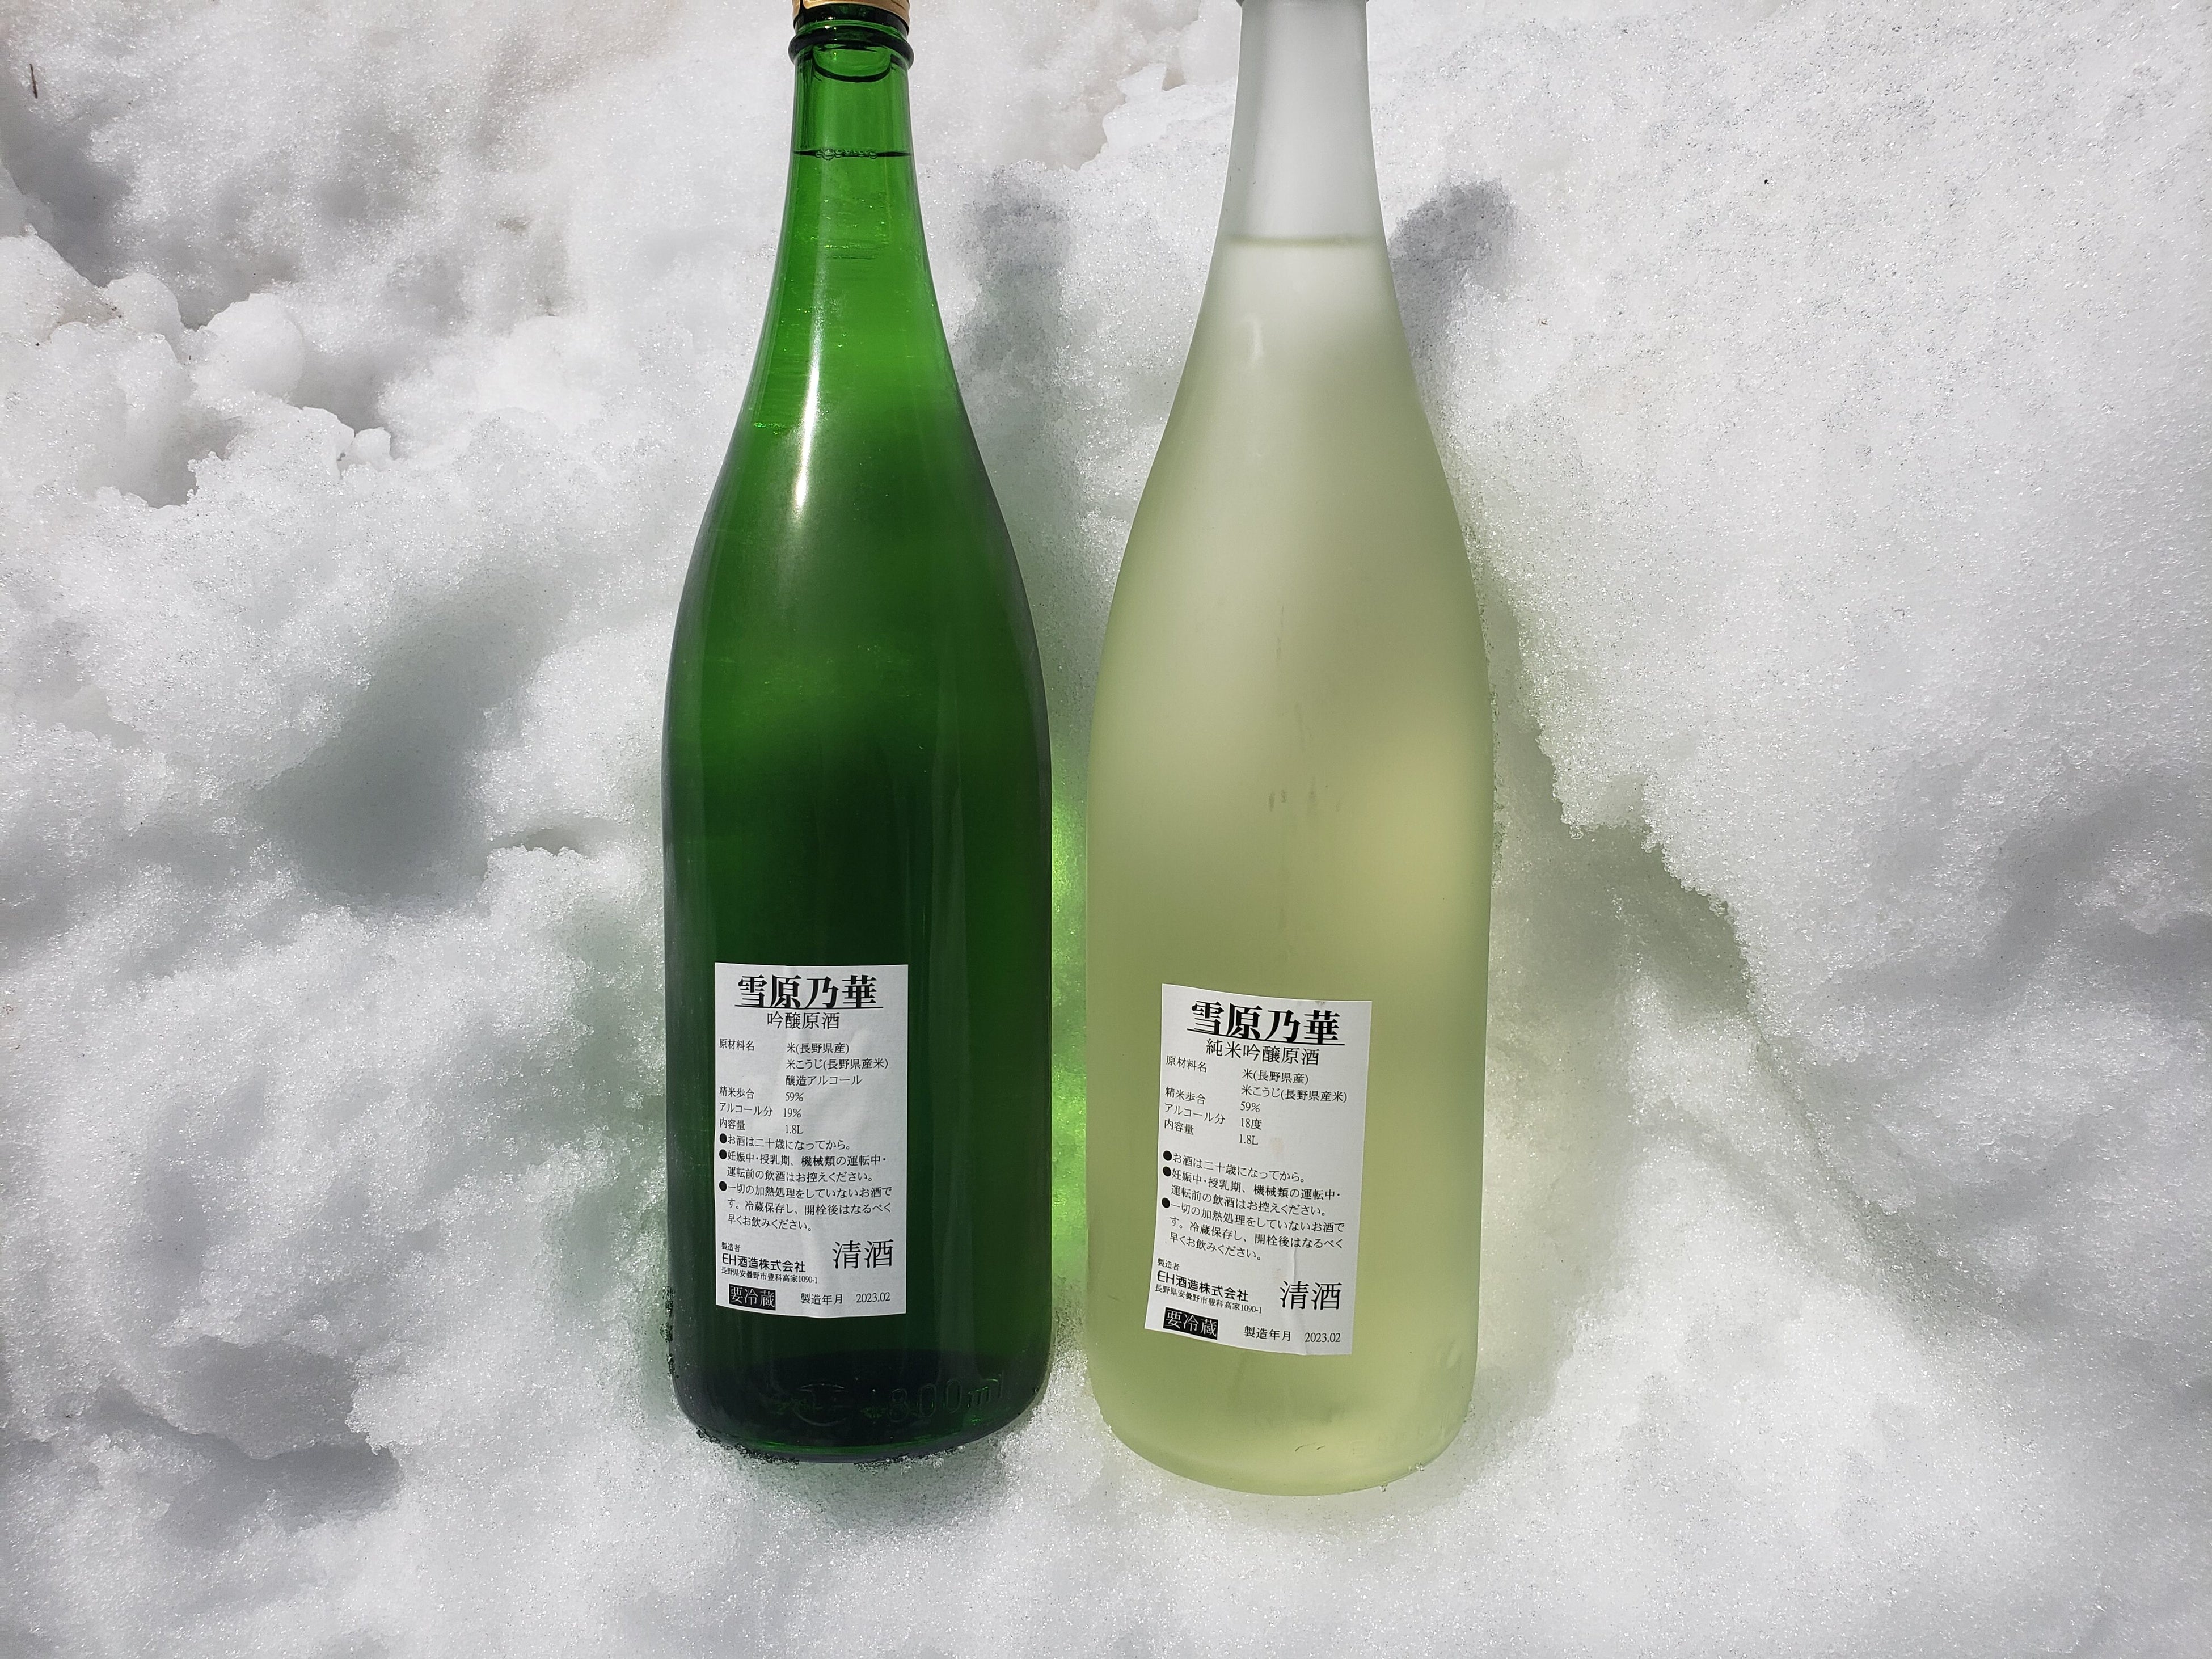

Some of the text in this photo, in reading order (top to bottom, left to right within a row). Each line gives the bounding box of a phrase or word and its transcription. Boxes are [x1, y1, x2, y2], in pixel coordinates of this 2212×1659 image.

[738, 974, 877, 1008] 雪原乃華
[767, 1011, 840, 1029] 吟醸原酒
[1191, 1001, 1340, 1045] 雪原乃華
[719, 1039, 849, 1054] 原材料名 米(長野県産)
[1206, 1038, 1319, 1066] 純米吟醸原酒
[786, 1058, 888, 1070] 米こうじ(長野県産米)
[1166, 1055, 1308, 1084] 原材料名 米(長野県産)
[786, 1075, 863, 1086] 醸造アルコール
[719, 1086, 804, 1102] 精米歩合 59%
[1165, 1087, 1260, 1113] 精米歩合 59%
[1241, 1084, 1347, 1103] 米こうじ(長野県産米)
[719, 1103, 801, 1118] アルコール分 19%
[1165, 1103, 1262, 1130] アルコール分 18度
[719, 1118, 804, 1134] 内容量 1.8L
[1164, 1119, 1259, 1145] 内容量 1.8L
[727, 1166, 872, 1183] 運転前の飲酒はお控えください。
[1171, 1184, 1327, 1217] 運転前の飲酒はお控えください。
[728, 1214, 812, 1231] 早くお飲みください。
[721, 1242, 740, 1252] 製造者
[832, 1239, 894, 1269] 清酒
[1170, 1232, 1261, 1260] 早くお飲みください。
[722, 1253, 806, 1273] EH酒造株式会社
[1158, 1258, 1180, 1271] 製造者
[1158, 1270, 1248, 1302] EH酒造株式会社
[1280, 1281, 1342, 1311] 清酒
[730, 1286, 776, 1309] 要冷蔵
[800, 1292, 890, 1305] 製造年月 2023.02
[1165, 1308, 1217, 1338] 要冷蔵
[1244, 1325, 1341, 1343] 製造年月 2023.02
